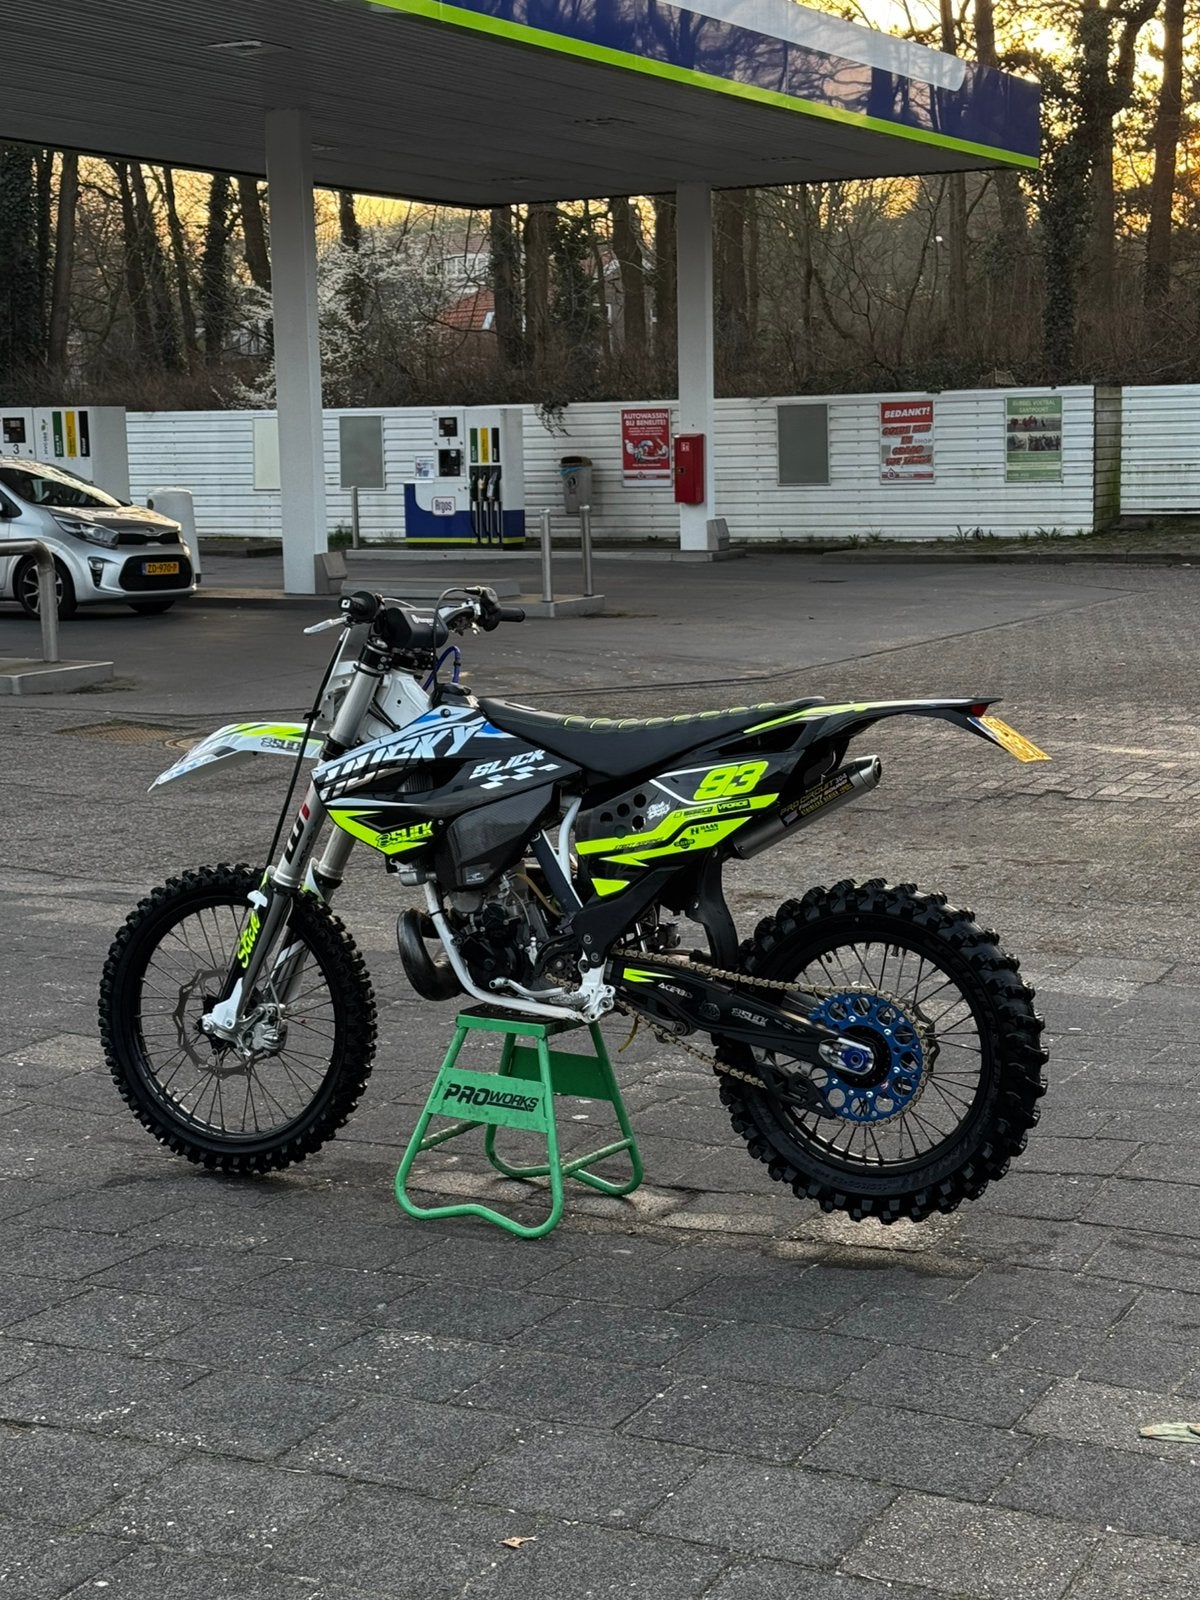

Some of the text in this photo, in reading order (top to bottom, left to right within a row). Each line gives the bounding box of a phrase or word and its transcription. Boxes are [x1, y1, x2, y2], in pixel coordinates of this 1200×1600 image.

[884, 407, 931, 419] BEDANKT!
[446, 438, 451, 446] 1
[13, 444, 20, 454] 3
[434, 500, 453, 514] Argos
[469, 750, 547, 779] SLICK
[693, 760, 769, 800] 93
